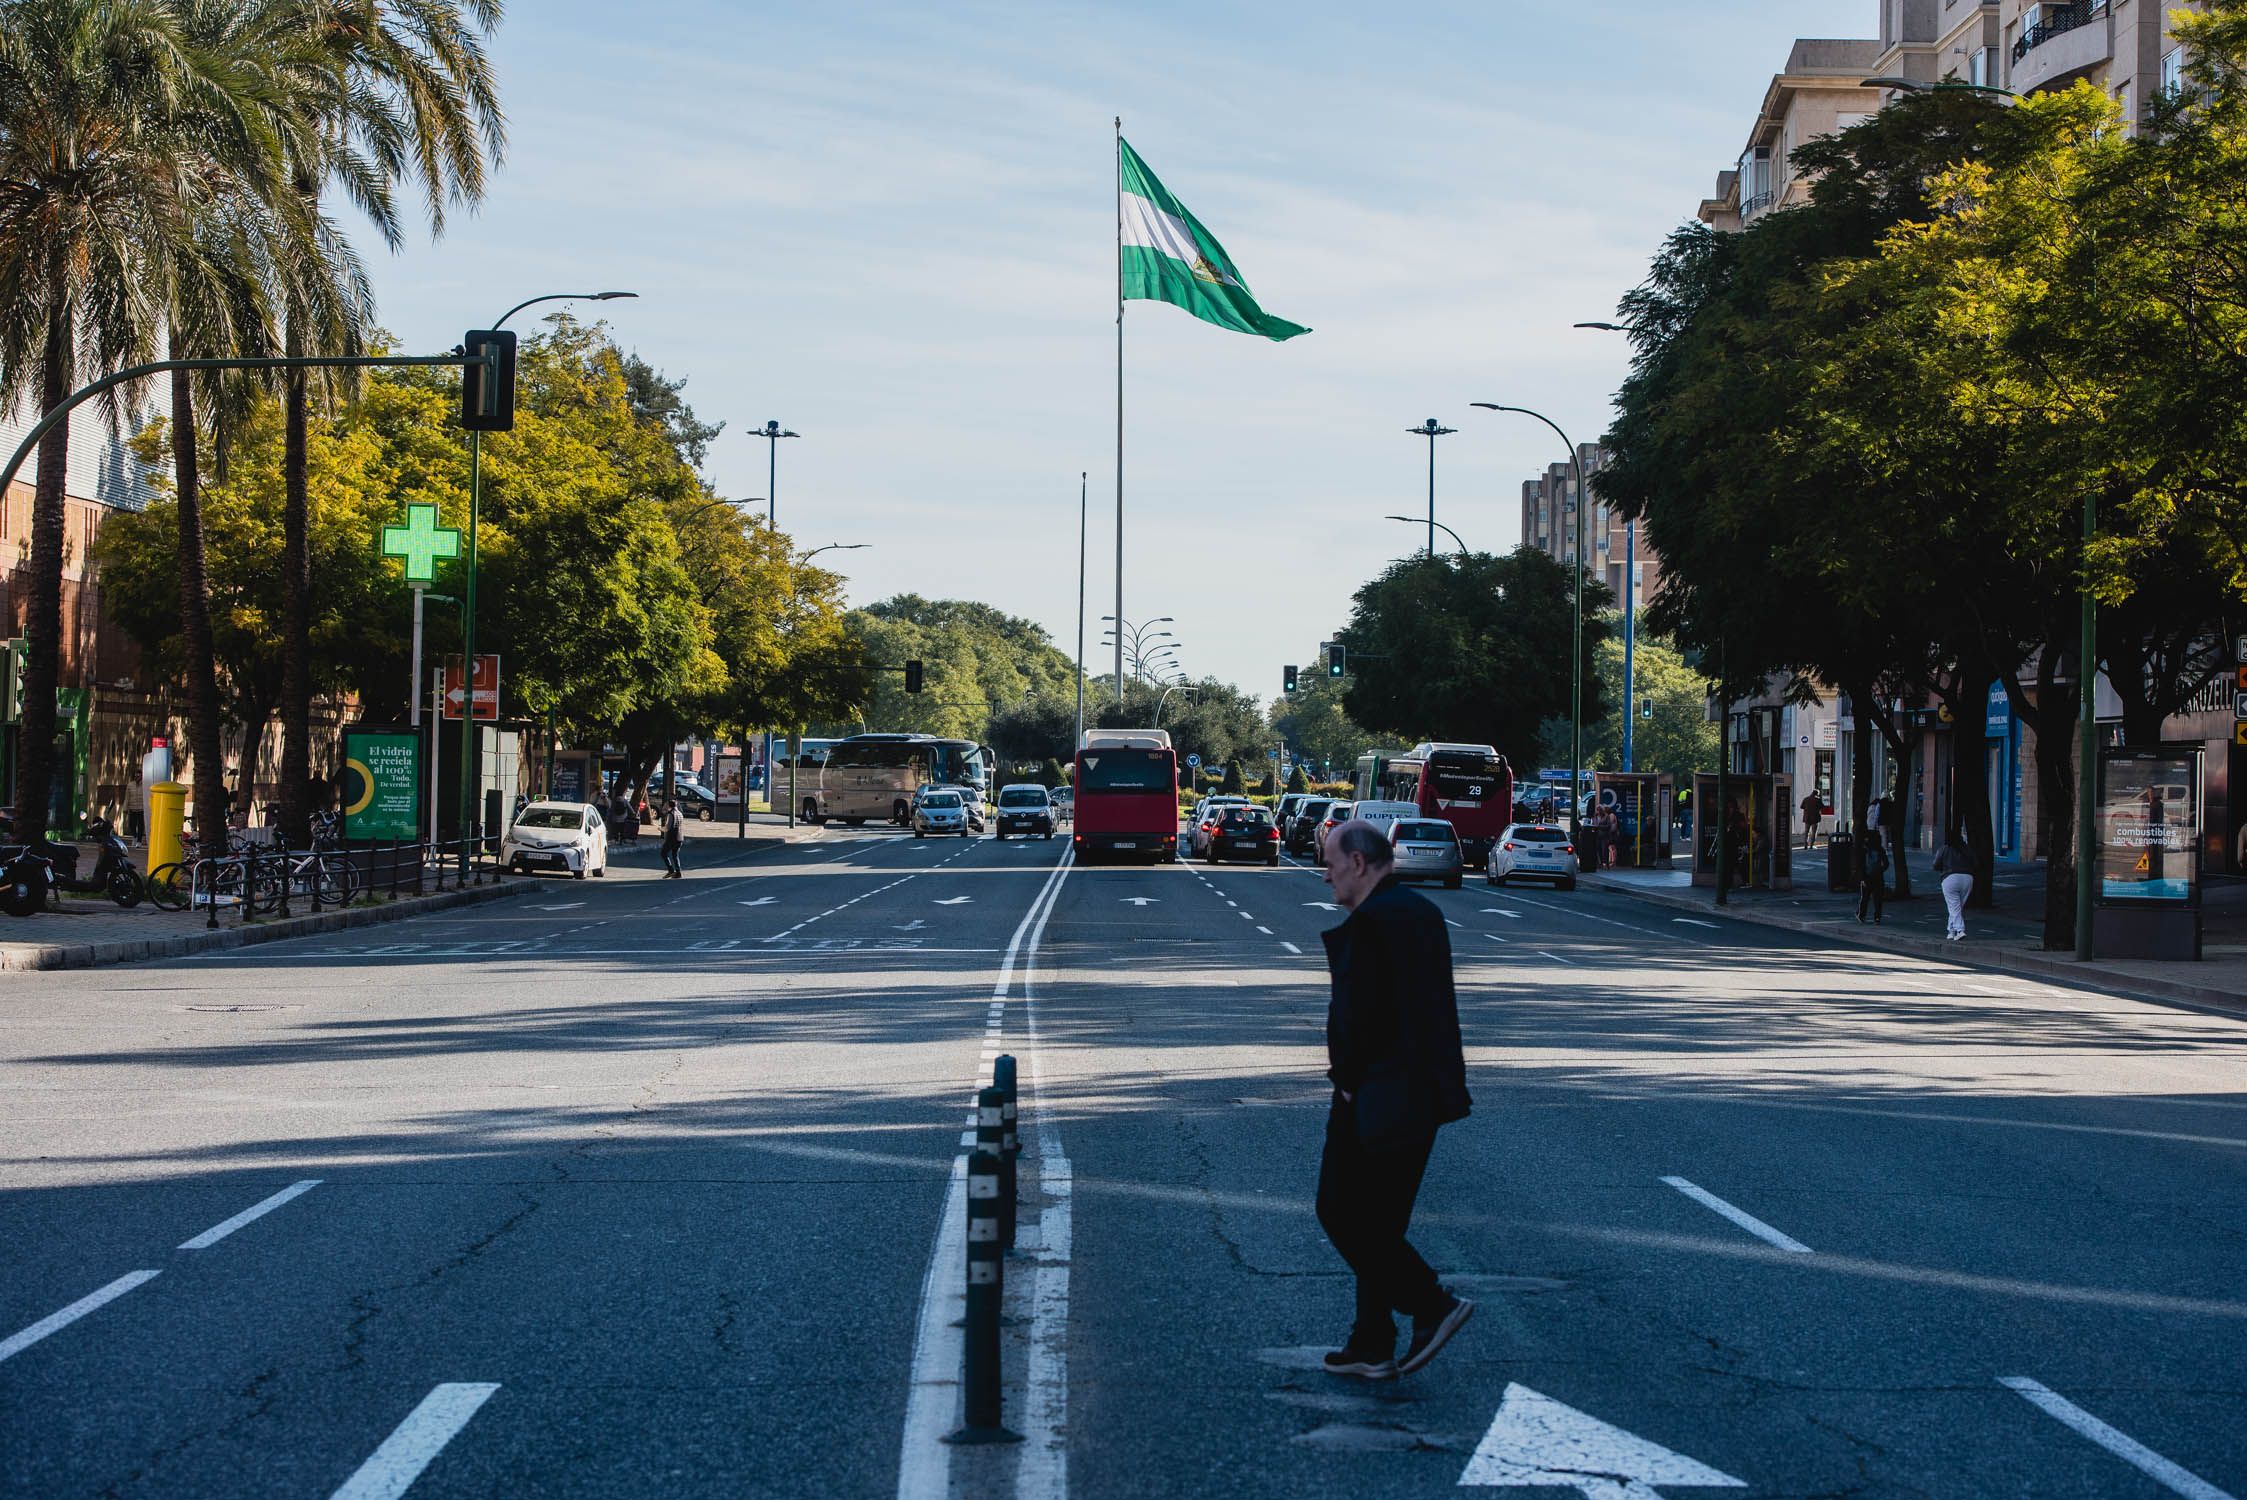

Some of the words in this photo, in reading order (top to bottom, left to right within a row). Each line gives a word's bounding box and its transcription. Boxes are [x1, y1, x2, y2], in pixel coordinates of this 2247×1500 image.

[369, 746, 379, 756] El
[382, 746, 412, 757] vidrio
[369, 758, 379, 766] se
[381, 756, 412, 766] recicla
[373, 765, 383, 774] al
[386, 766, 412, 774] 100%
[1469, 786, 1482, 796] 29
[2117, 827, 2177, 838] combustibles
[2112, 836, 2133, 846] 100%
